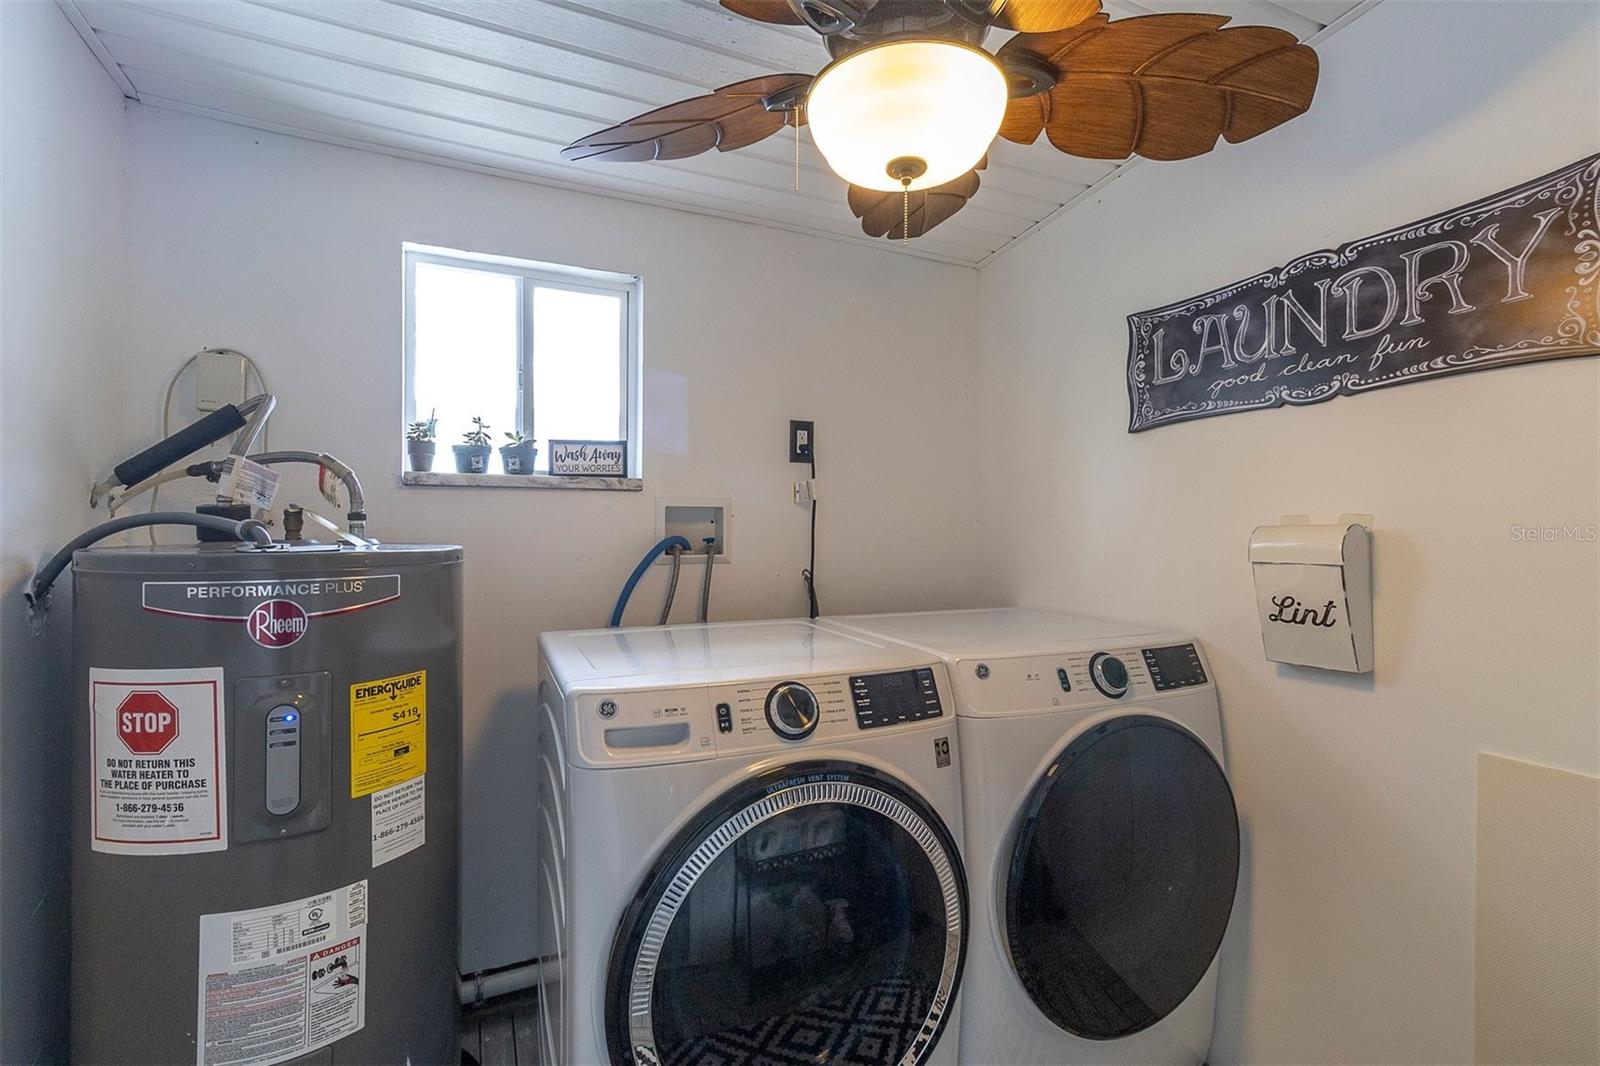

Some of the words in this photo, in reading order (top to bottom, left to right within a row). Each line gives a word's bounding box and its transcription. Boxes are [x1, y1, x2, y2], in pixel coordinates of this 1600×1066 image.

[1152, 207, 1564, 386] LAUNDRY
[1207, 370, 1270, 398] good
[1278, 353, 1359, 377] clean
[1370, 334, 1431, 371] fun
[555, 444, 587, 463] Wash
[589, 448, 621, 465] Away
[556, 464, 580, 473] YOUR
[581, 464, 621, 473] WORRIES
[187, 583, 320, 599] PERFORMANCE
[255, 601, 304, 641] Rheem
[1268, 596, 1337, 628] Lint
[355, 676, 422, 700] ENERGYGUIDE
[122, 712, 171, 733] STOP
[106, 759, 116, 768] DO
[118, 759, 133, 769] NOT
[135, 759, 171, 769] RETURN
[173, 758, 196, 768] THIS
[100, 779, 113, 789] THE
[115, 780, 140, 790] PLACE
[142, 781, 153, 790] OF
[155, 779, 207, 790] PURCHASE
[111, 770, 137, 779] WATER
[139, 769, 174, 780] HEATER
[177, 769, 190, 779] TO
[766, 776, 805, 794] ULTRAFRESH
[807, 774, 824, 783] VENT
[827, 774, 849, 782] SYSTEM
[322, 938, 358, 957] DANGER
